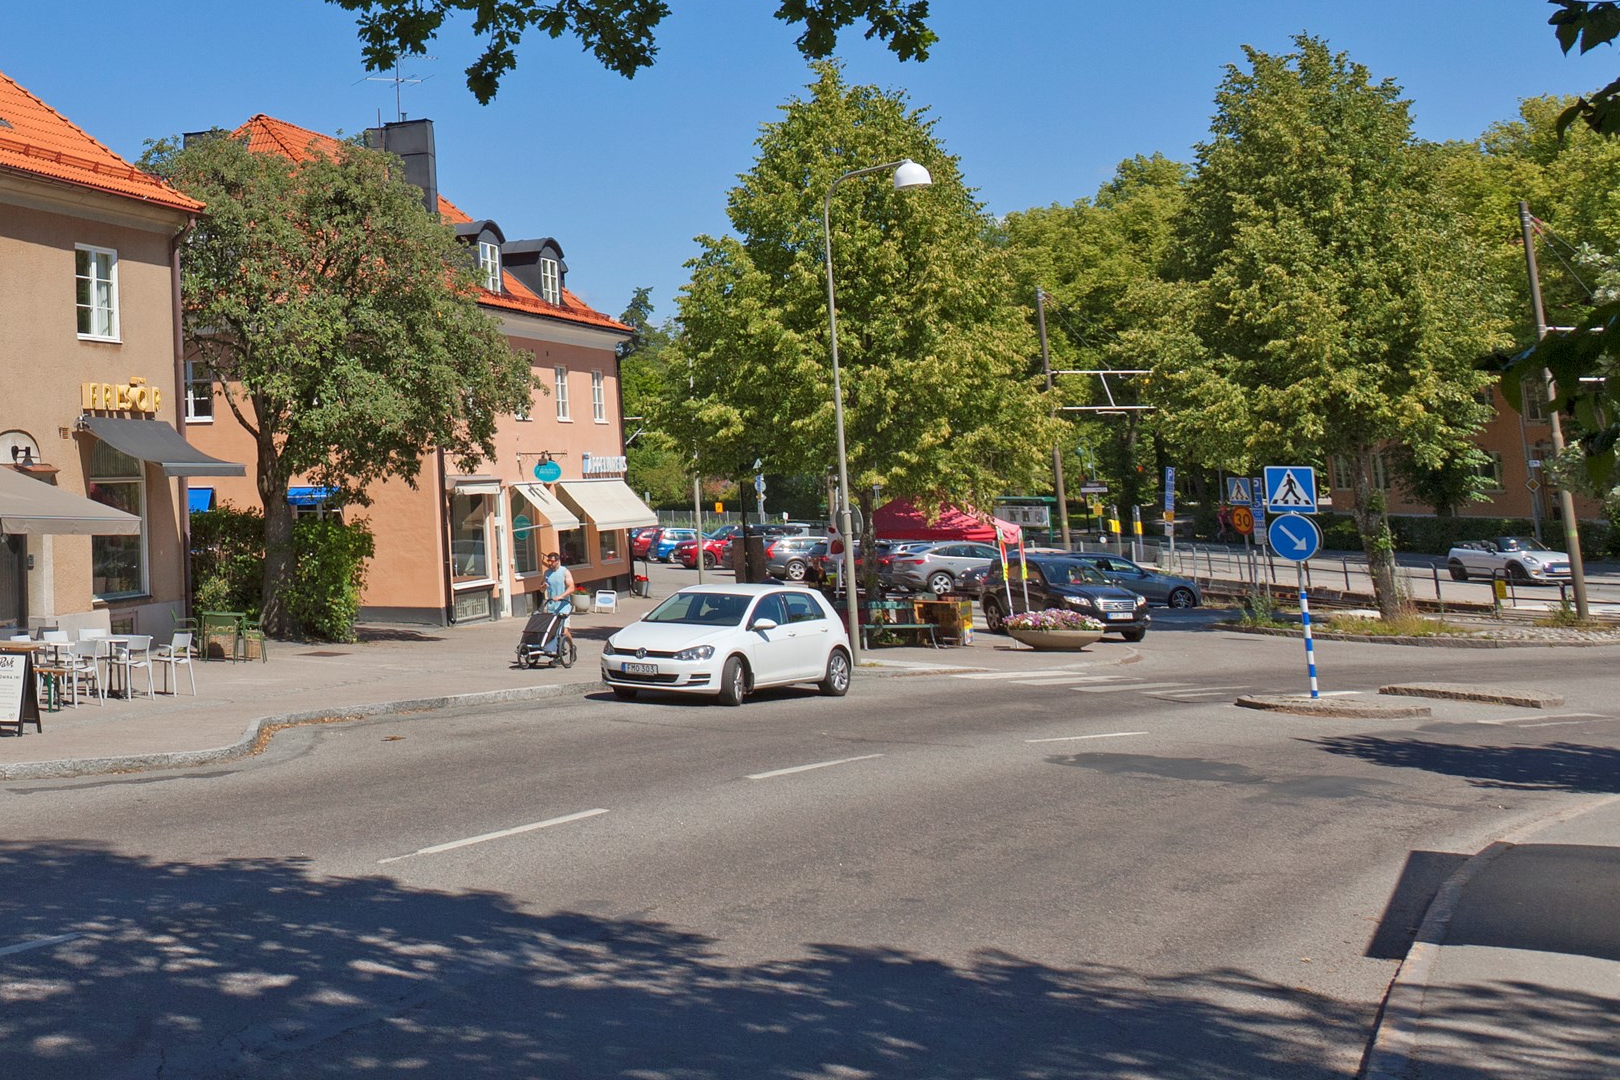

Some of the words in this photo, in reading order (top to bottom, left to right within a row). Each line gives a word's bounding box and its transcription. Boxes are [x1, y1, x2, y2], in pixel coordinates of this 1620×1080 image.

[81, 376, 162, 413] FRISÖR
[1235, 512, 1251, 527] 30
[641, 664, 654, 673] 303
